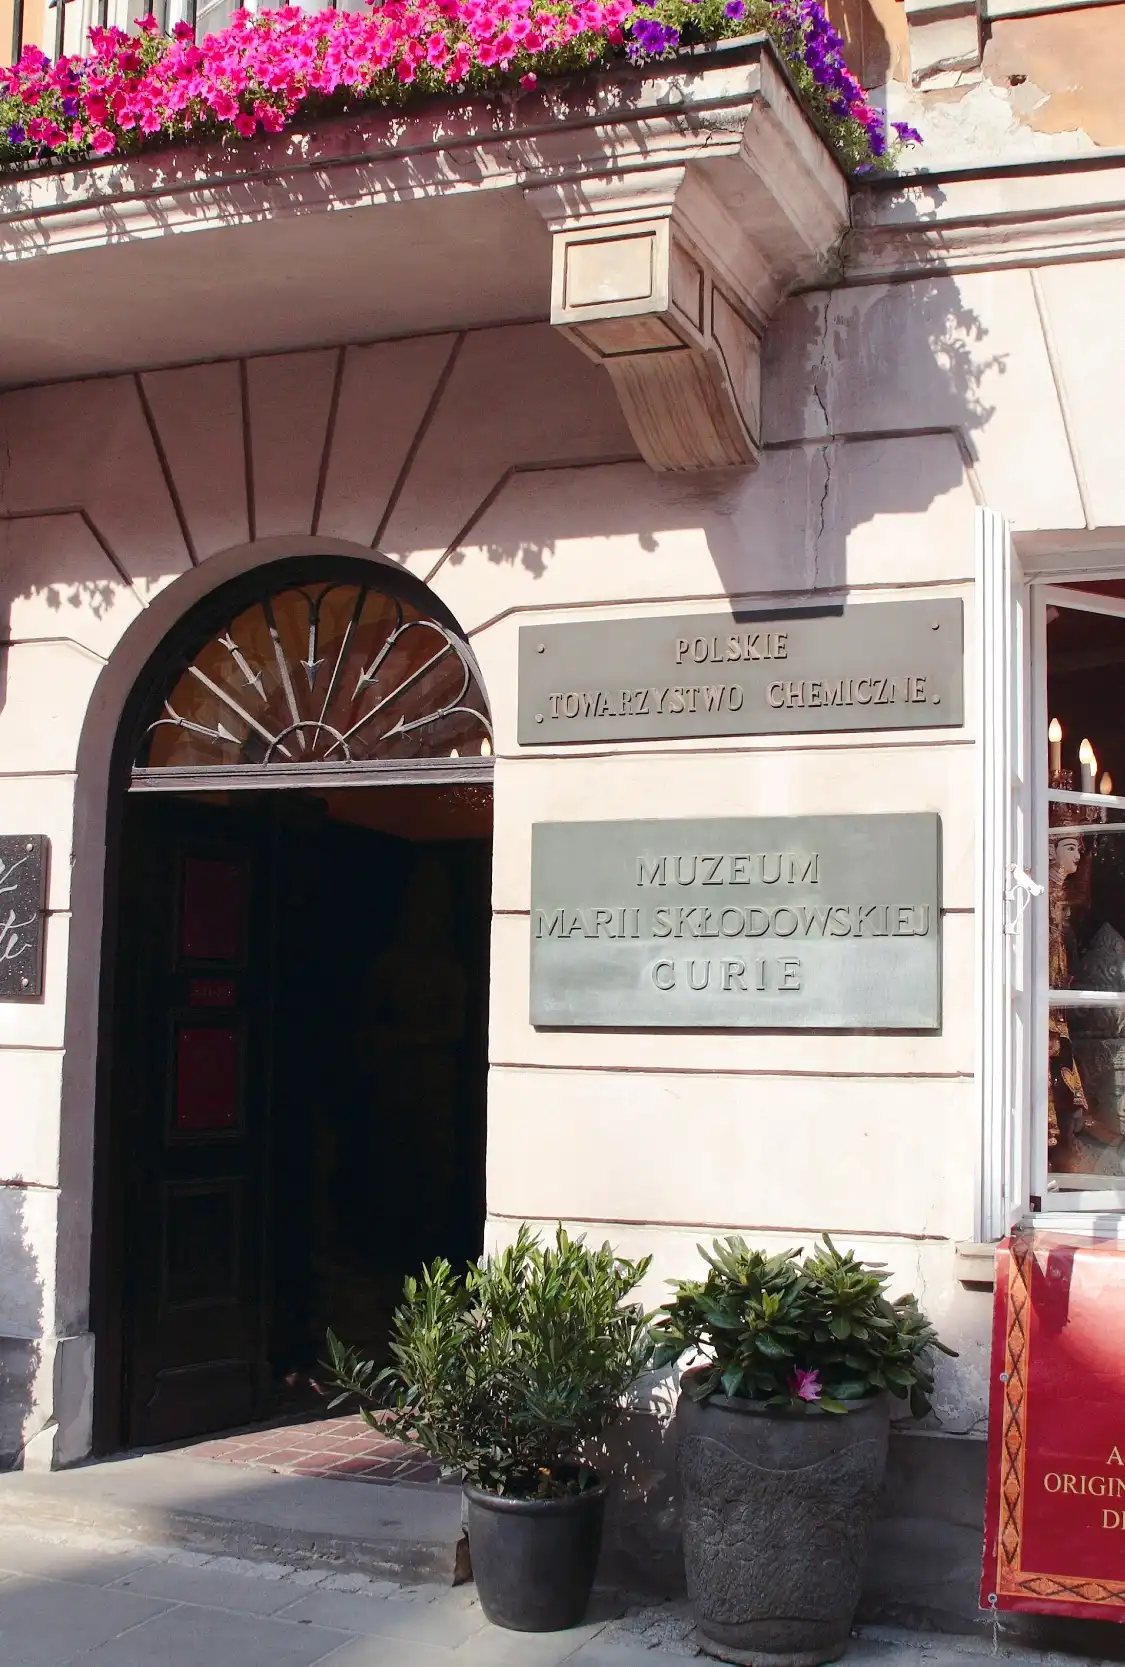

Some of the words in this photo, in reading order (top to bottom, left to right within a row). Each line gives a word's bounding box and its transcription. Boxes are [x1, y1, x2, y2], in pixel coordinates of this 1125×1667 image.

[675, 632, 790, 665] POLSKIE
[549, 683, 745, 719] TOWARZYSTWO
[767, 676, 927, 709] CHEMICZNE
[636, 852, 821, 887] MUZEUM
[535, 906, 641, 939] MARII
[651, 903, 931, 939] SKŁODOWSKIEJ
[651, 956, 802, 992] CURIE
